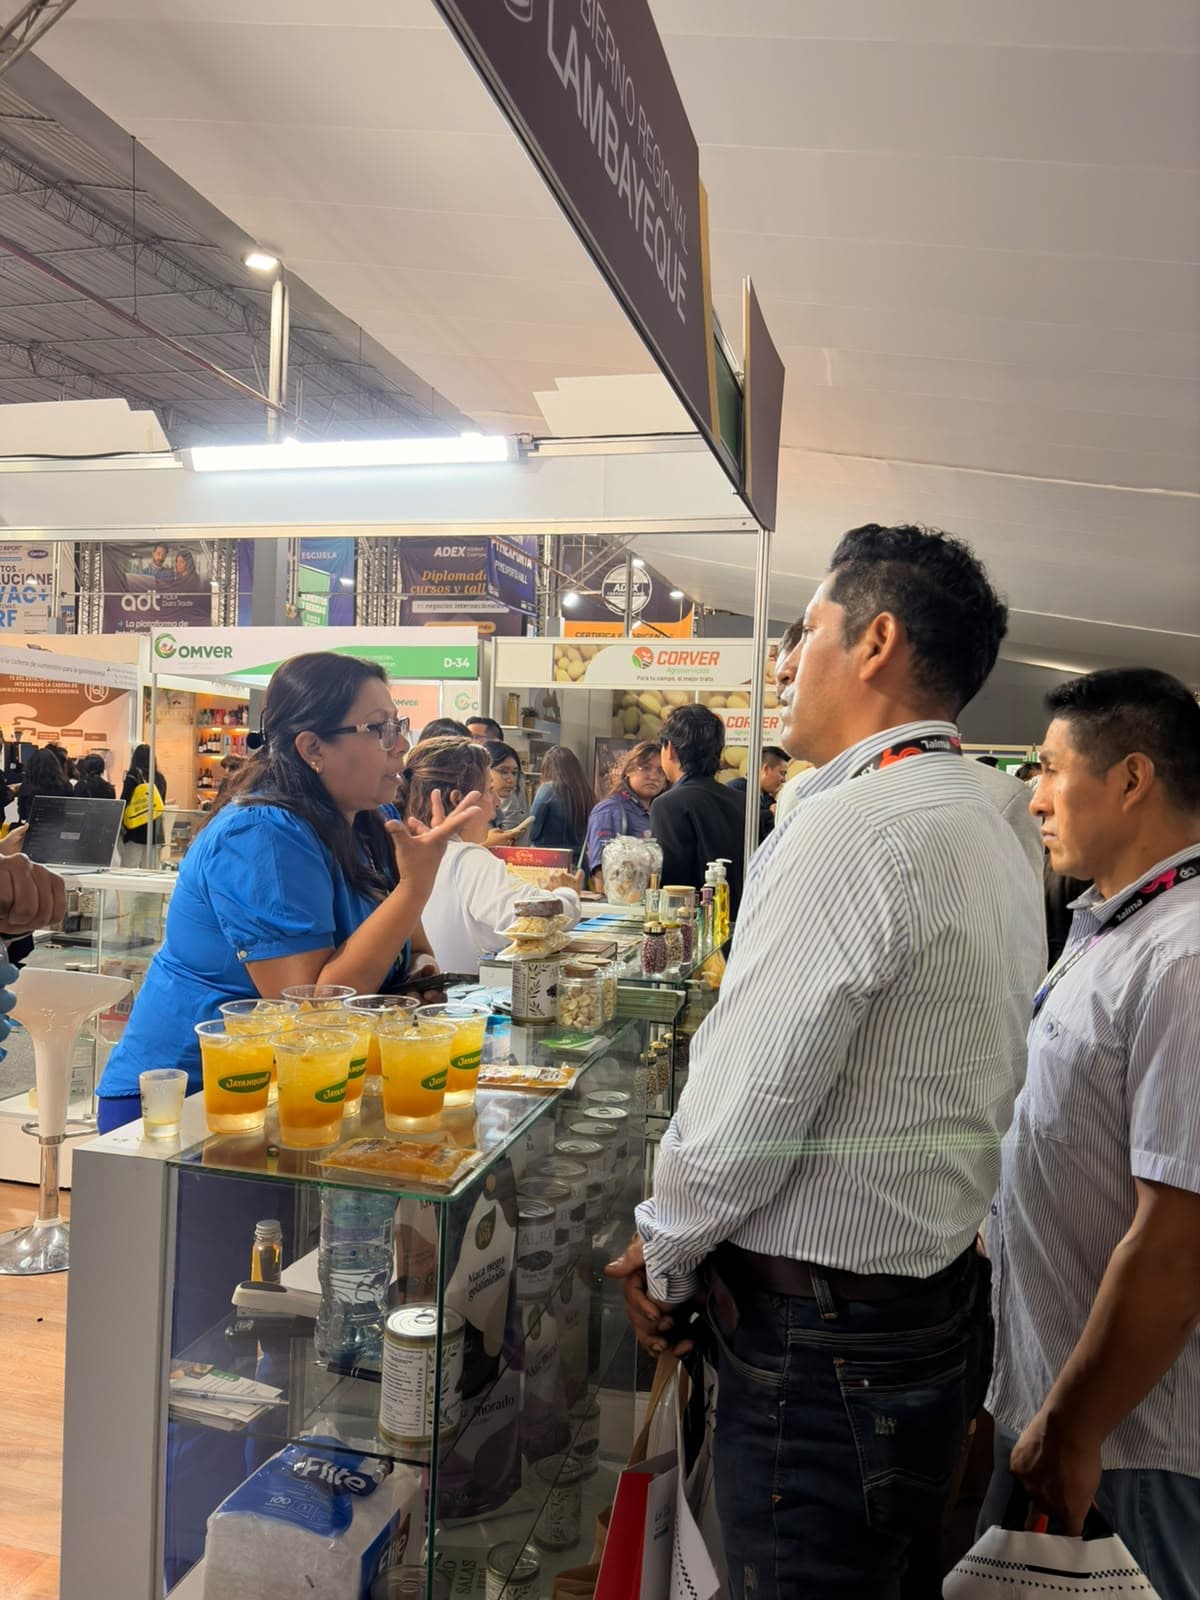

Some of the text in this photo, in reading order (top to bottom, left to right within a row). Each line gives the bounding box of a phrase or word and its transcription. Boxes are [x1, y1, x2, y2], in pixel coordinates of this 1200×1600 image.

[547, 0, 687, 324] LAMBAYEQUE
[638, 104, 688, 255] REGIONAL
[302, 551, 337, 560] ESCUELA
[434, 546, 466, 557] ADEX
[411, 585, 449, 594] cursos
[613, 583, 640, 592] ADX
[121, 590, 160, 611] adt
[125, 620, 135, 628] La
[444, 657, 470, 668] D-34
[656, 651, 720, 666] CORVER
[726, 716, 779, 729] CORER
